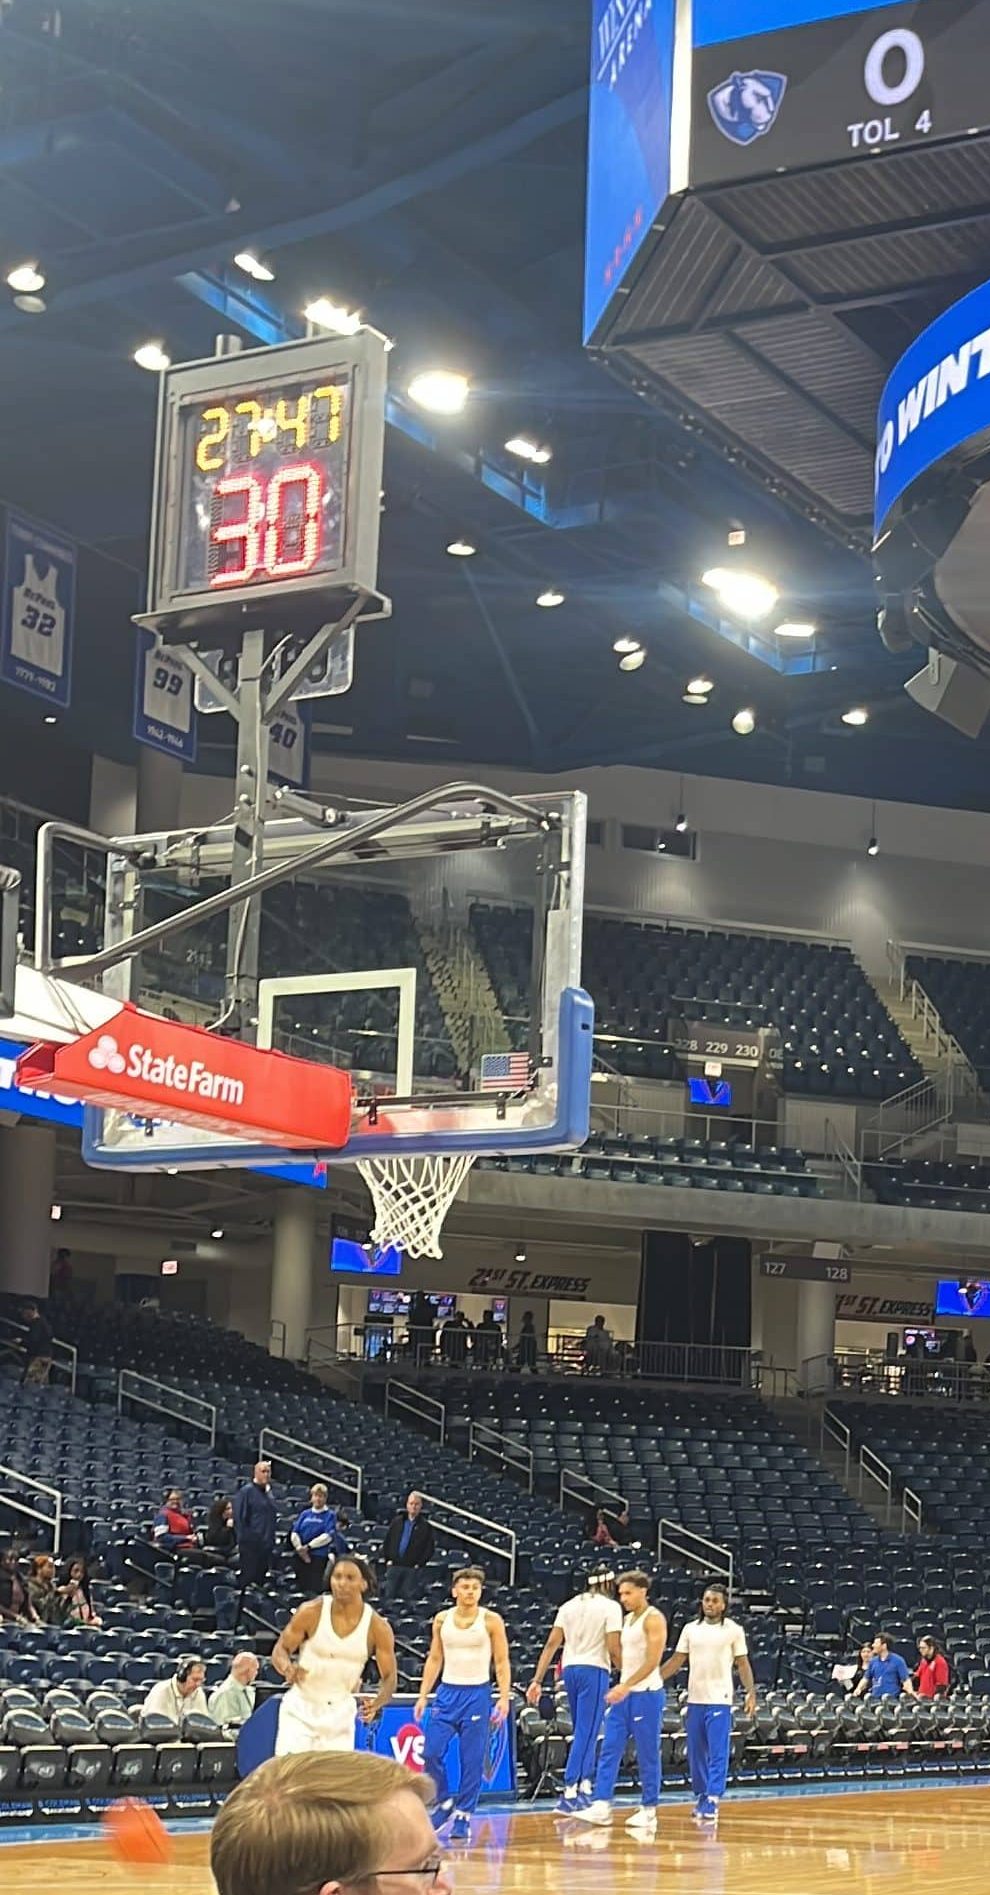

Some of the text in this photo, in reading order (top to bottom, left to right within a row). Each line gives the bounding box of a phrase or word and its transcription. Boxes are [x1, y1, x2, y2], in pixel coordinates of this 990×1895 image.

[864, 28, 925, 106] 0
[847, 109, 932, 148] TOL 4
[196, 385, 343, 471] 27:47
[210, 462, 322, 587] 30
[20, 604, 57, 637] 32
[152, 667, 183, 696] 99
[269, 722, 297, 749] 40
[705, 1041, 729, 1053] 229
[735, 1044, 759, 1057] 230
[531, 1274, 591, 1293] EXPRESS
[765, 1261, 848, 1280] 127 128
[836, 1293, 855, 1313] 1ST
[879, 1299, 934, 1317] EXPRESS
[390, 1732, 426, 1766] VS
